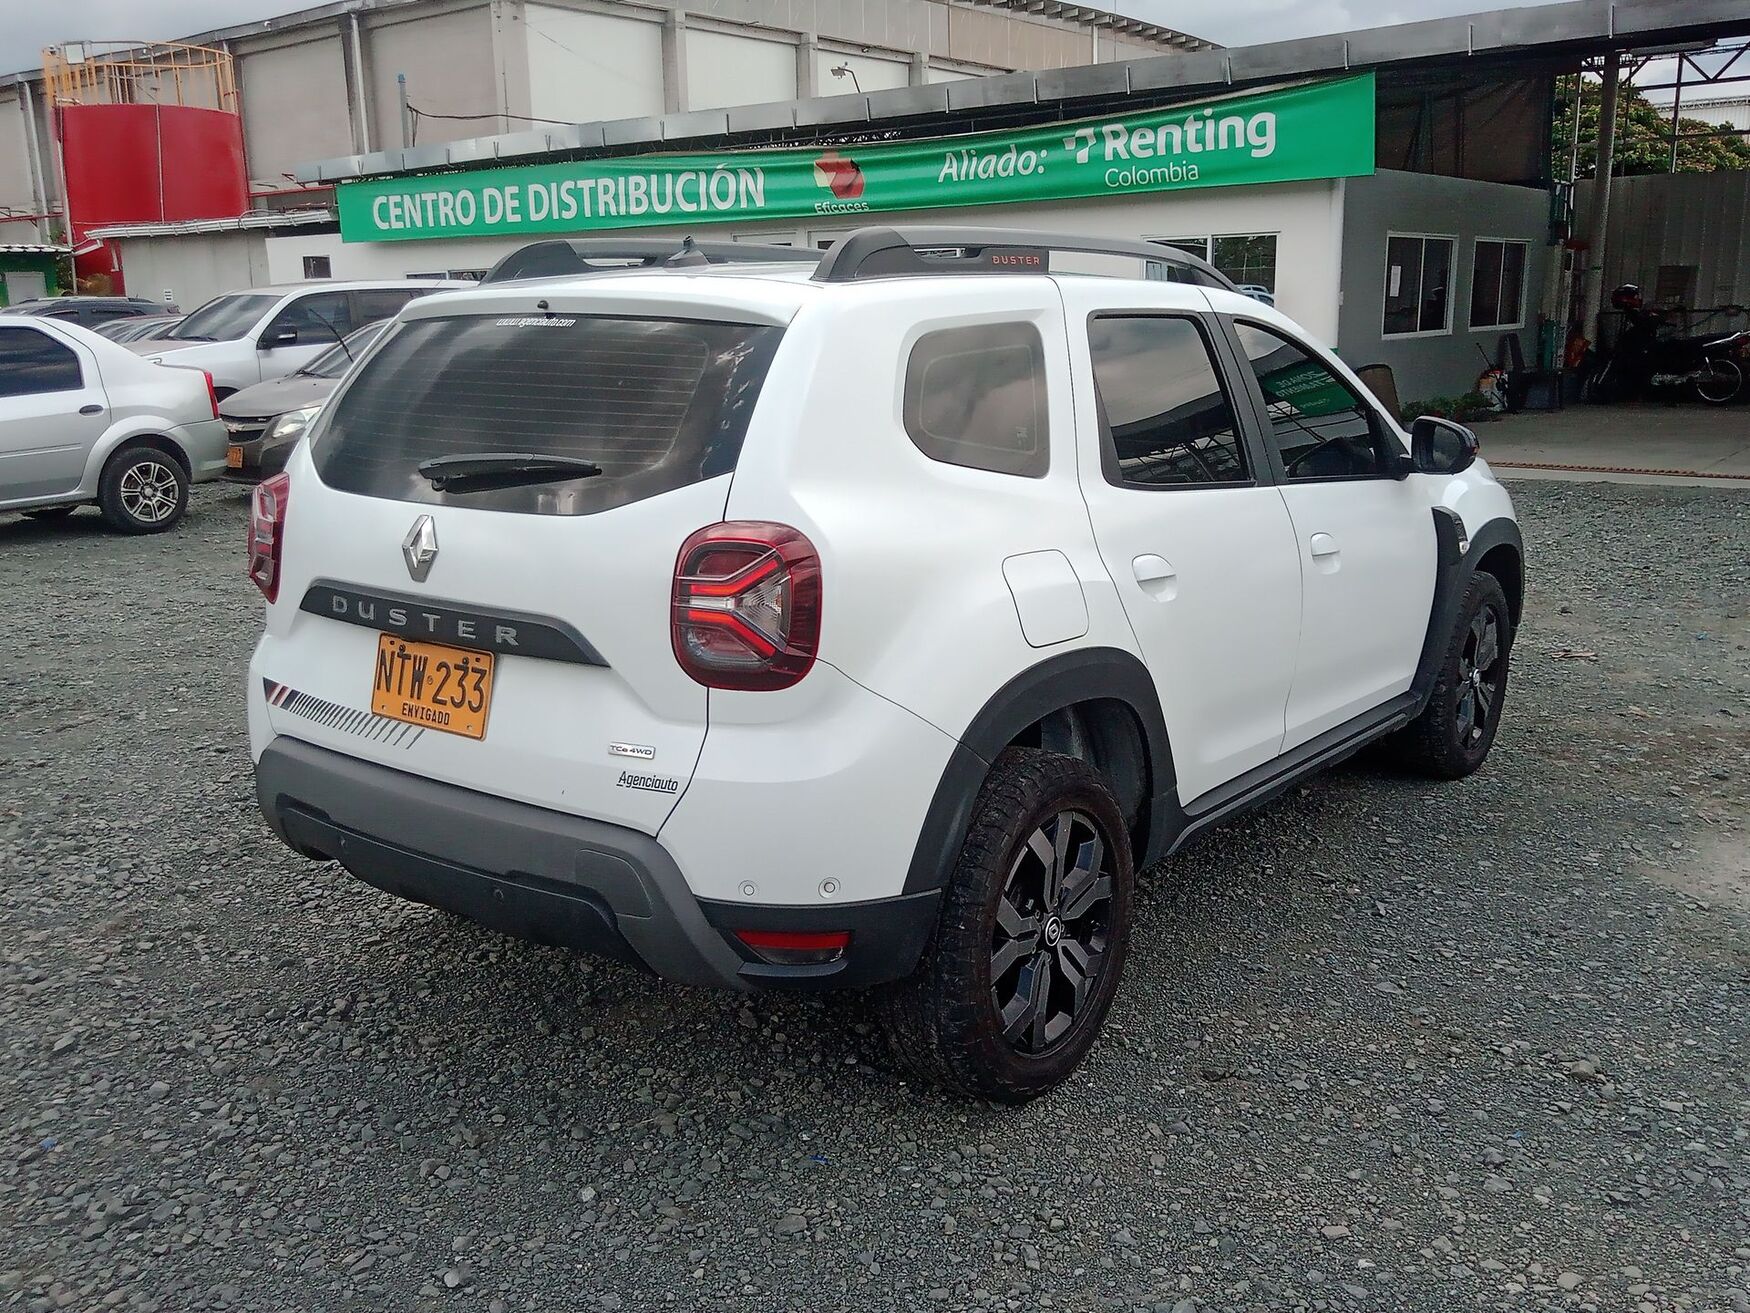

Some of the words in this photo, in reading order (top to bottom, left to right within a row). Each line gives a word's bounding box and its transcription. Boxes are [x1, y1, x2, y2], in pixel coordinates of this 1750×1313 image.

[1104, 108, 1277, 161] Renting
[937, 148, 1049, 184] Aliado:
[1104, 162, 1200, 189] Colombia
[372, 189, 476, 231] CENTRO
[482, 186, 521, 225] DE
[528, 163, 766, 222] DISTRIBUCIÓN
[815, 201, 869, 214] Eficaces
[992, 255, 1040, 265] DUSTER
[332, 594, 520, 647] DUSTER
[401, 702, 451, 726] ENVIGADO
[629, 748, 653, 756] 4WD
[617, 770, 679, 793] Agenciauto
